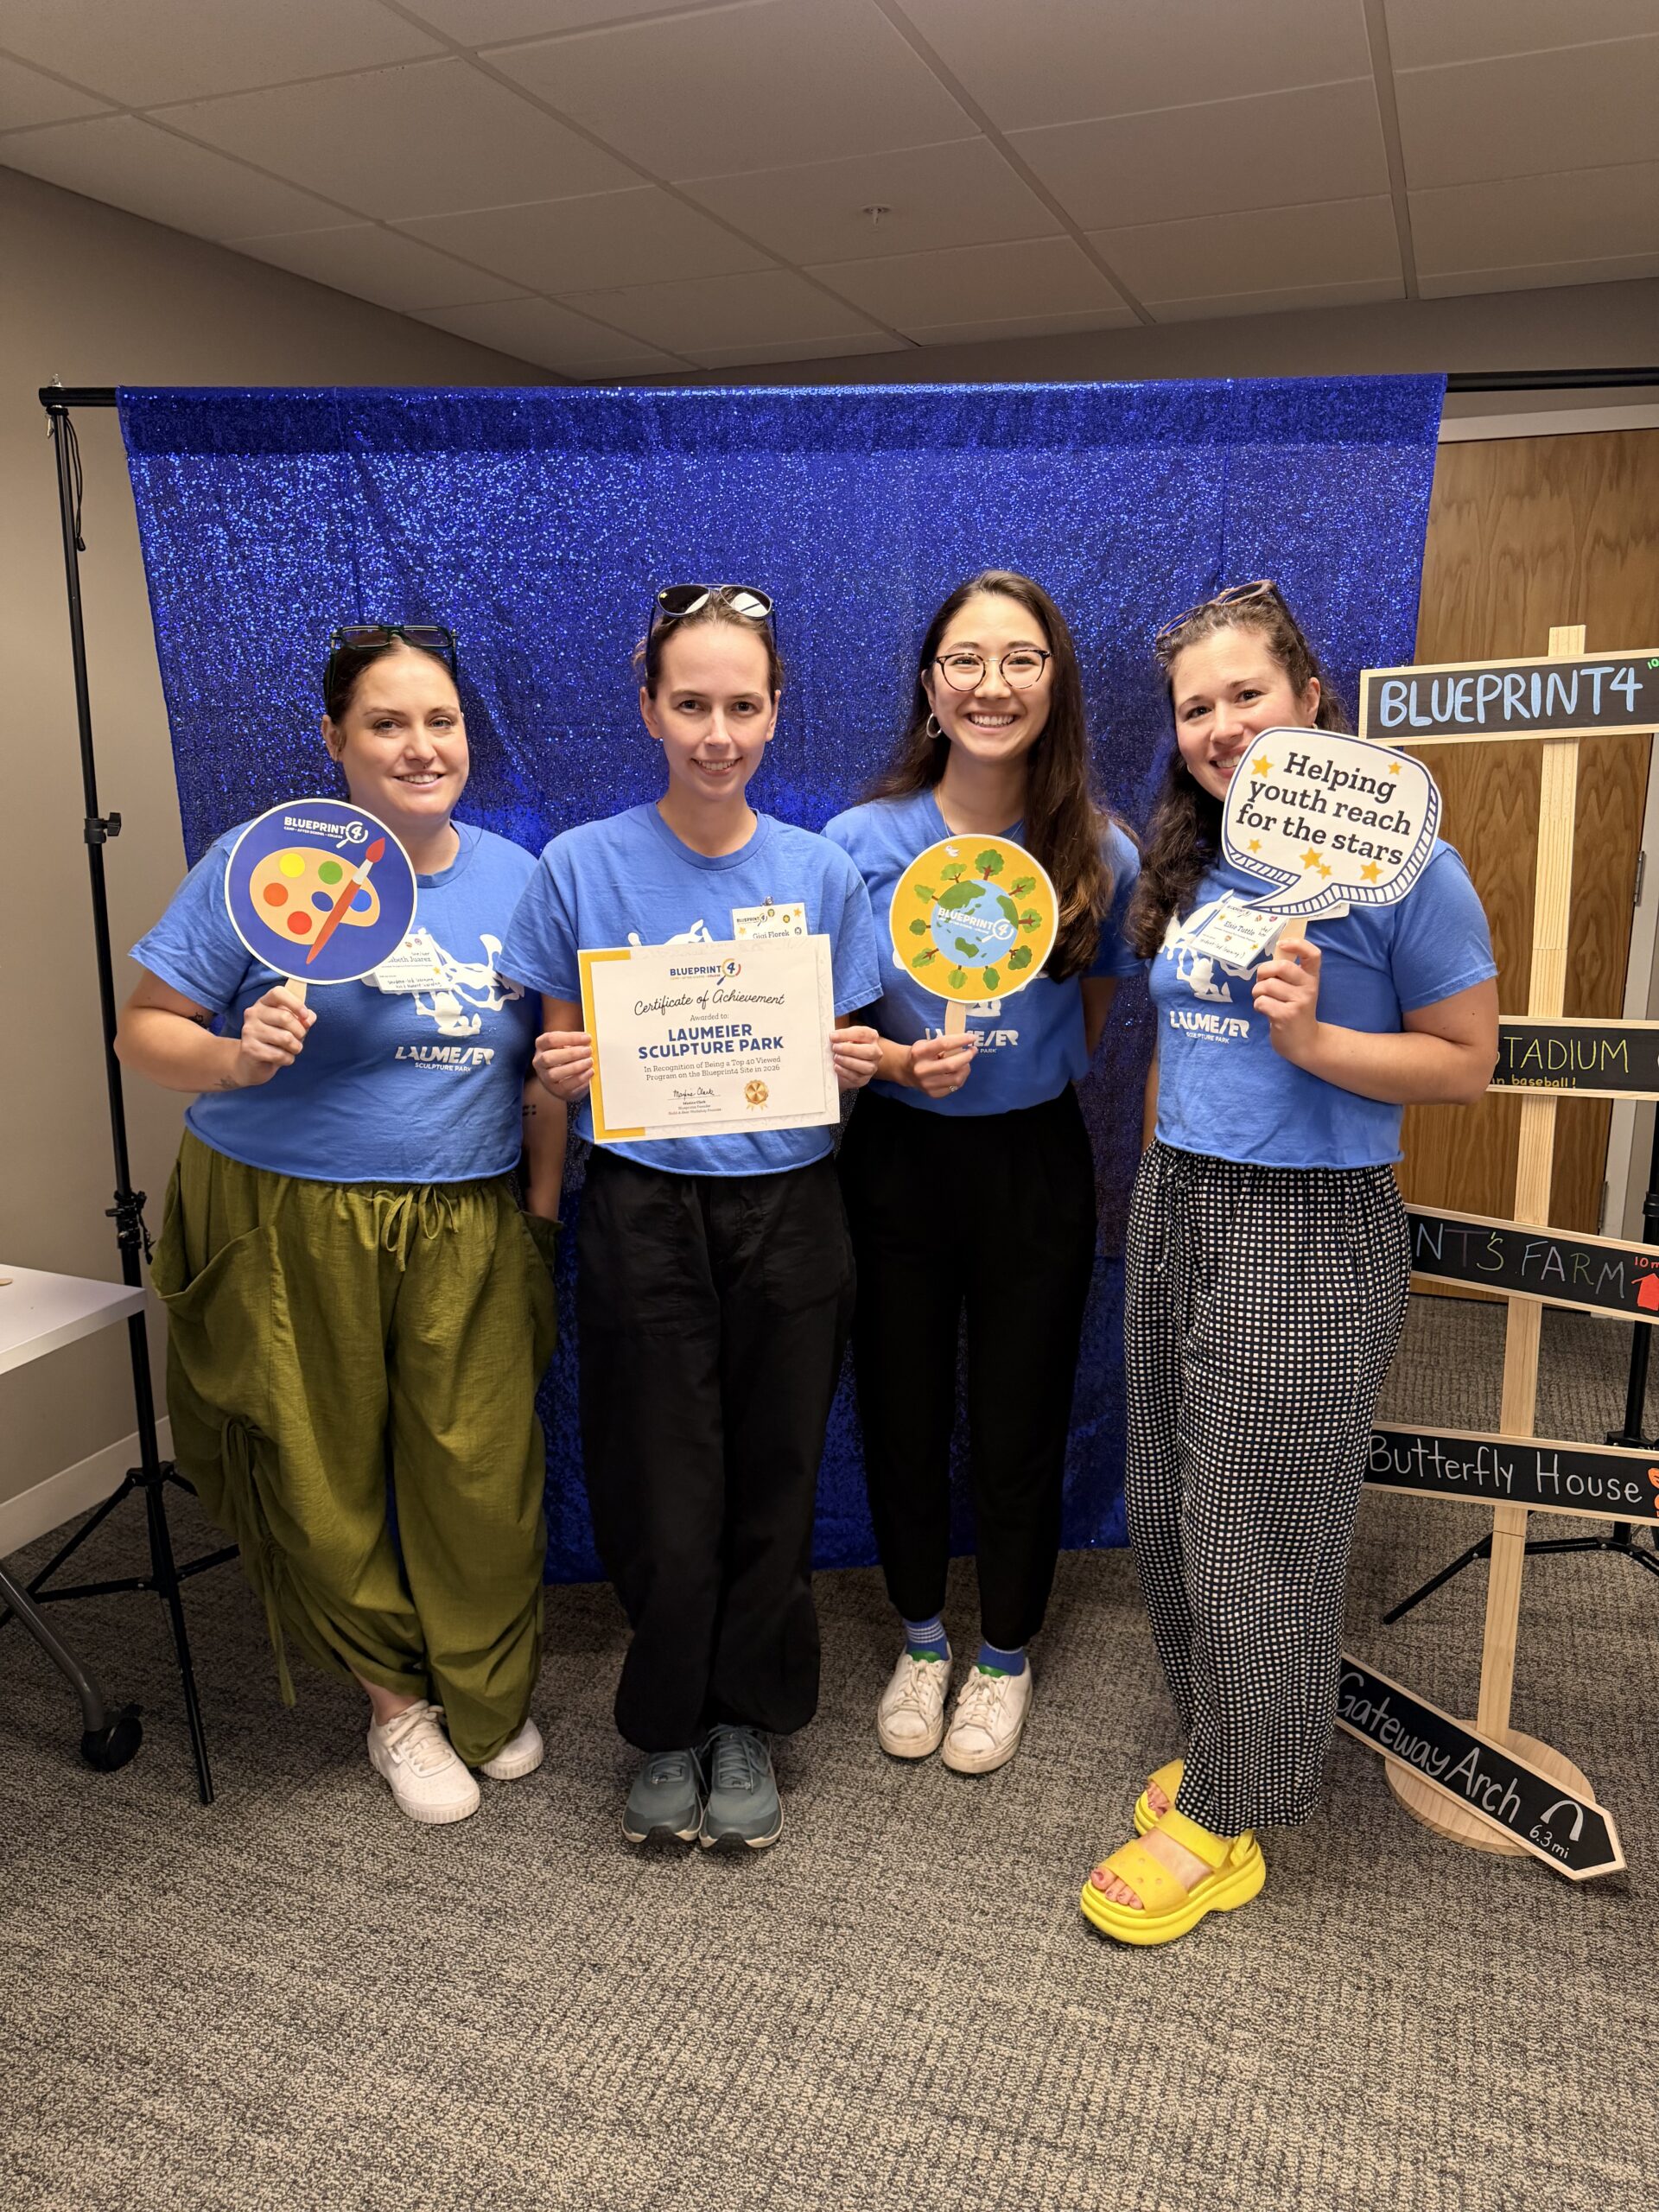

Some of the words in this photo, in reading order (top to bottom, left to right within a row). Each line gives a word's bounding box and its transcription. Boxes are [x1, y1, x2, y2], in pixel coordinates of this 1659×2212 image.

[1380, 667, 1643, 728] BLUEPRINT4
[1283, 752, 1397, 804] Helping
[1247, 780, 1328, 814] youth
[1332, 801, 1412, 836] reach
[1236, 803, 1277, 831] for
[1282, 816, 1327, 845] the
[1332, 832, 1405, 865] stars
[768, 930, 790, 938] Florek
[1237, 925, 1255, 936] Tuttle
[634, 994, 693, 1016] Certificate
[696, 989, 709, 1010] of
[712, 989, 785, 1005] Achievement
[638, 1040, 734, 1059] SCULPTURE
[739, 1036, 785, 1052] PARK
[668, 1024, 753, 1042] LAUMEIER
[415, 1062, 454, 1071] SCULPTURE
[653, 1063, 695, 1072] Recognition
[1496, 1036, 1629, 1073] TADIUM
[646, 1072, 677, 1081] Program
[702, 1068, 739, 1077] Blueprint4
[1522, 1240, 1624, 1299] FARM
[1368, 1434, 1513, 1494] Butterfly
[1536, 1451, 1643, 1503] House
[1338, 1672, 1451, 1777] Gateway
[1444, 1746, 1521, 1823] Arch
[1529, 1824, 1553, 1847] 6.3
[1551, 1843, 1570, 1859] mi
